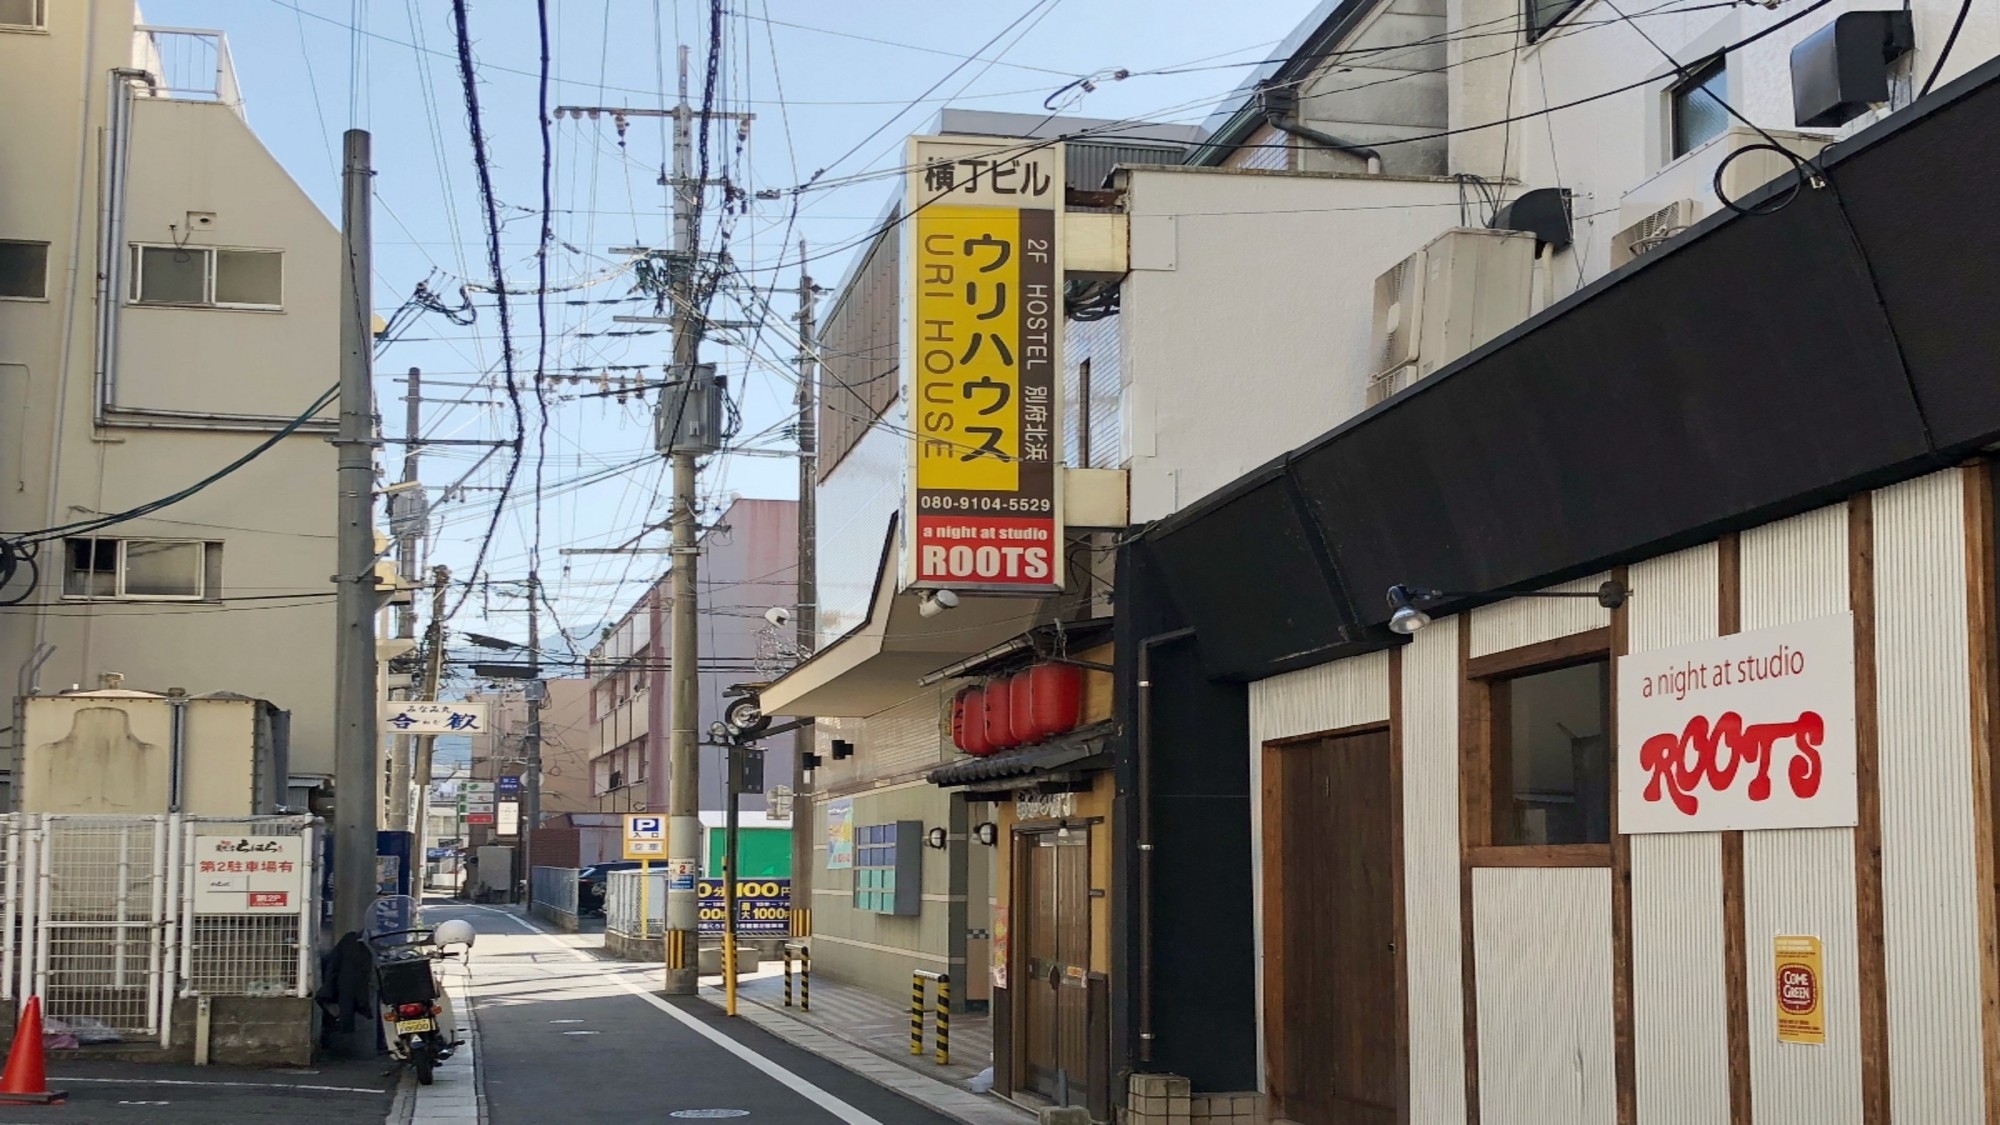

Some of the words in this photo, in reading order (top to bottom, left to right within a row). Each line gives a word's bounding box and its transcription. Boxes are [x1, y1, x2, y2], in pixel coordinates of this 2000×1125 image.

[925, 157, 1051, 196] 横丁ビル
[924, 234, 955, 297] URI
[1026, 238, 1048, 264] 2F
[1026, 284, 1048, 371] HOSTEL
[959, 233, 1014, 463] ウリハウス
[924, 319, 955, 459] HOUSE
[1024, 385, 1049, 463] 別府北浜
[921, 495, 1051, 512] 080-9104-5529
[922, 526, 933, 538] a
[936, 524, 977, 541] night
[980, 526, 996, 540] at
[998, 526, 1048, 541] studio
[922, 545, 1049, 579] ROOTS
[1642, 675, 1653, 698] a
[1657, 660, 1708, 701] night
[1712, 659, 1732, 687] at
[1737, 644, 1805, 684] studio
[1639, 710, 1825, 816] ROOTS
[636, 819, 657, 831] P
[199, 860, 294, 873] 第2駐車場有
[1783, 984, 1810, 999] GREEN
[1784, 971, 1809, 986] COME
